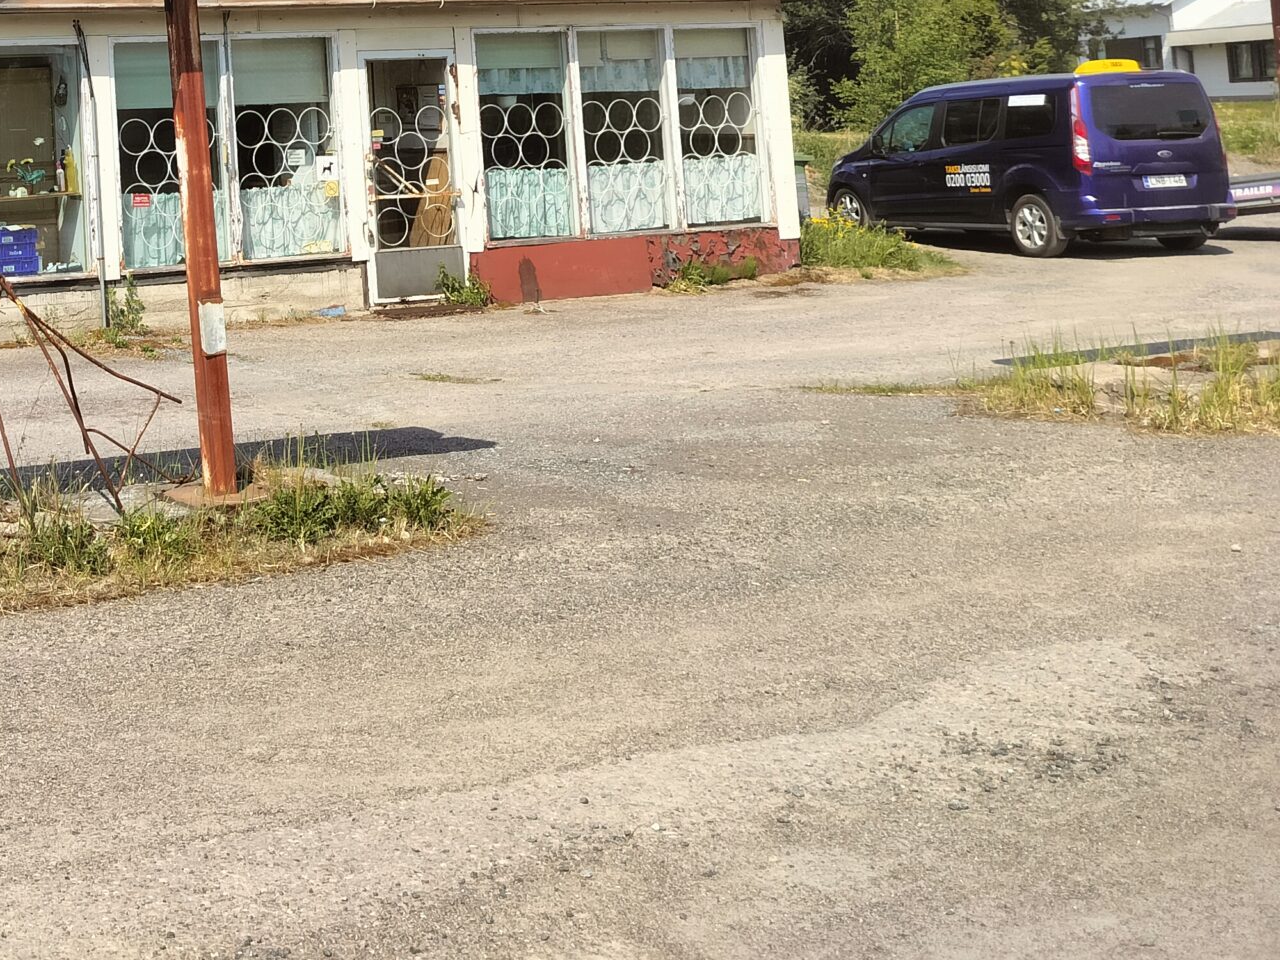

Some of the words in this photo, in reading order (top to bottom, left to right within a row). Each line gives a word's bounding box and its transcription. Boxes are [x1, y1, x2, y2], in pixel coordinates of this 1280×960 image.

[945, 174, 965, 187] 0200
[965, 173, 991, 187] 03000
[1231, 185, 1273, 197] TRAILER
